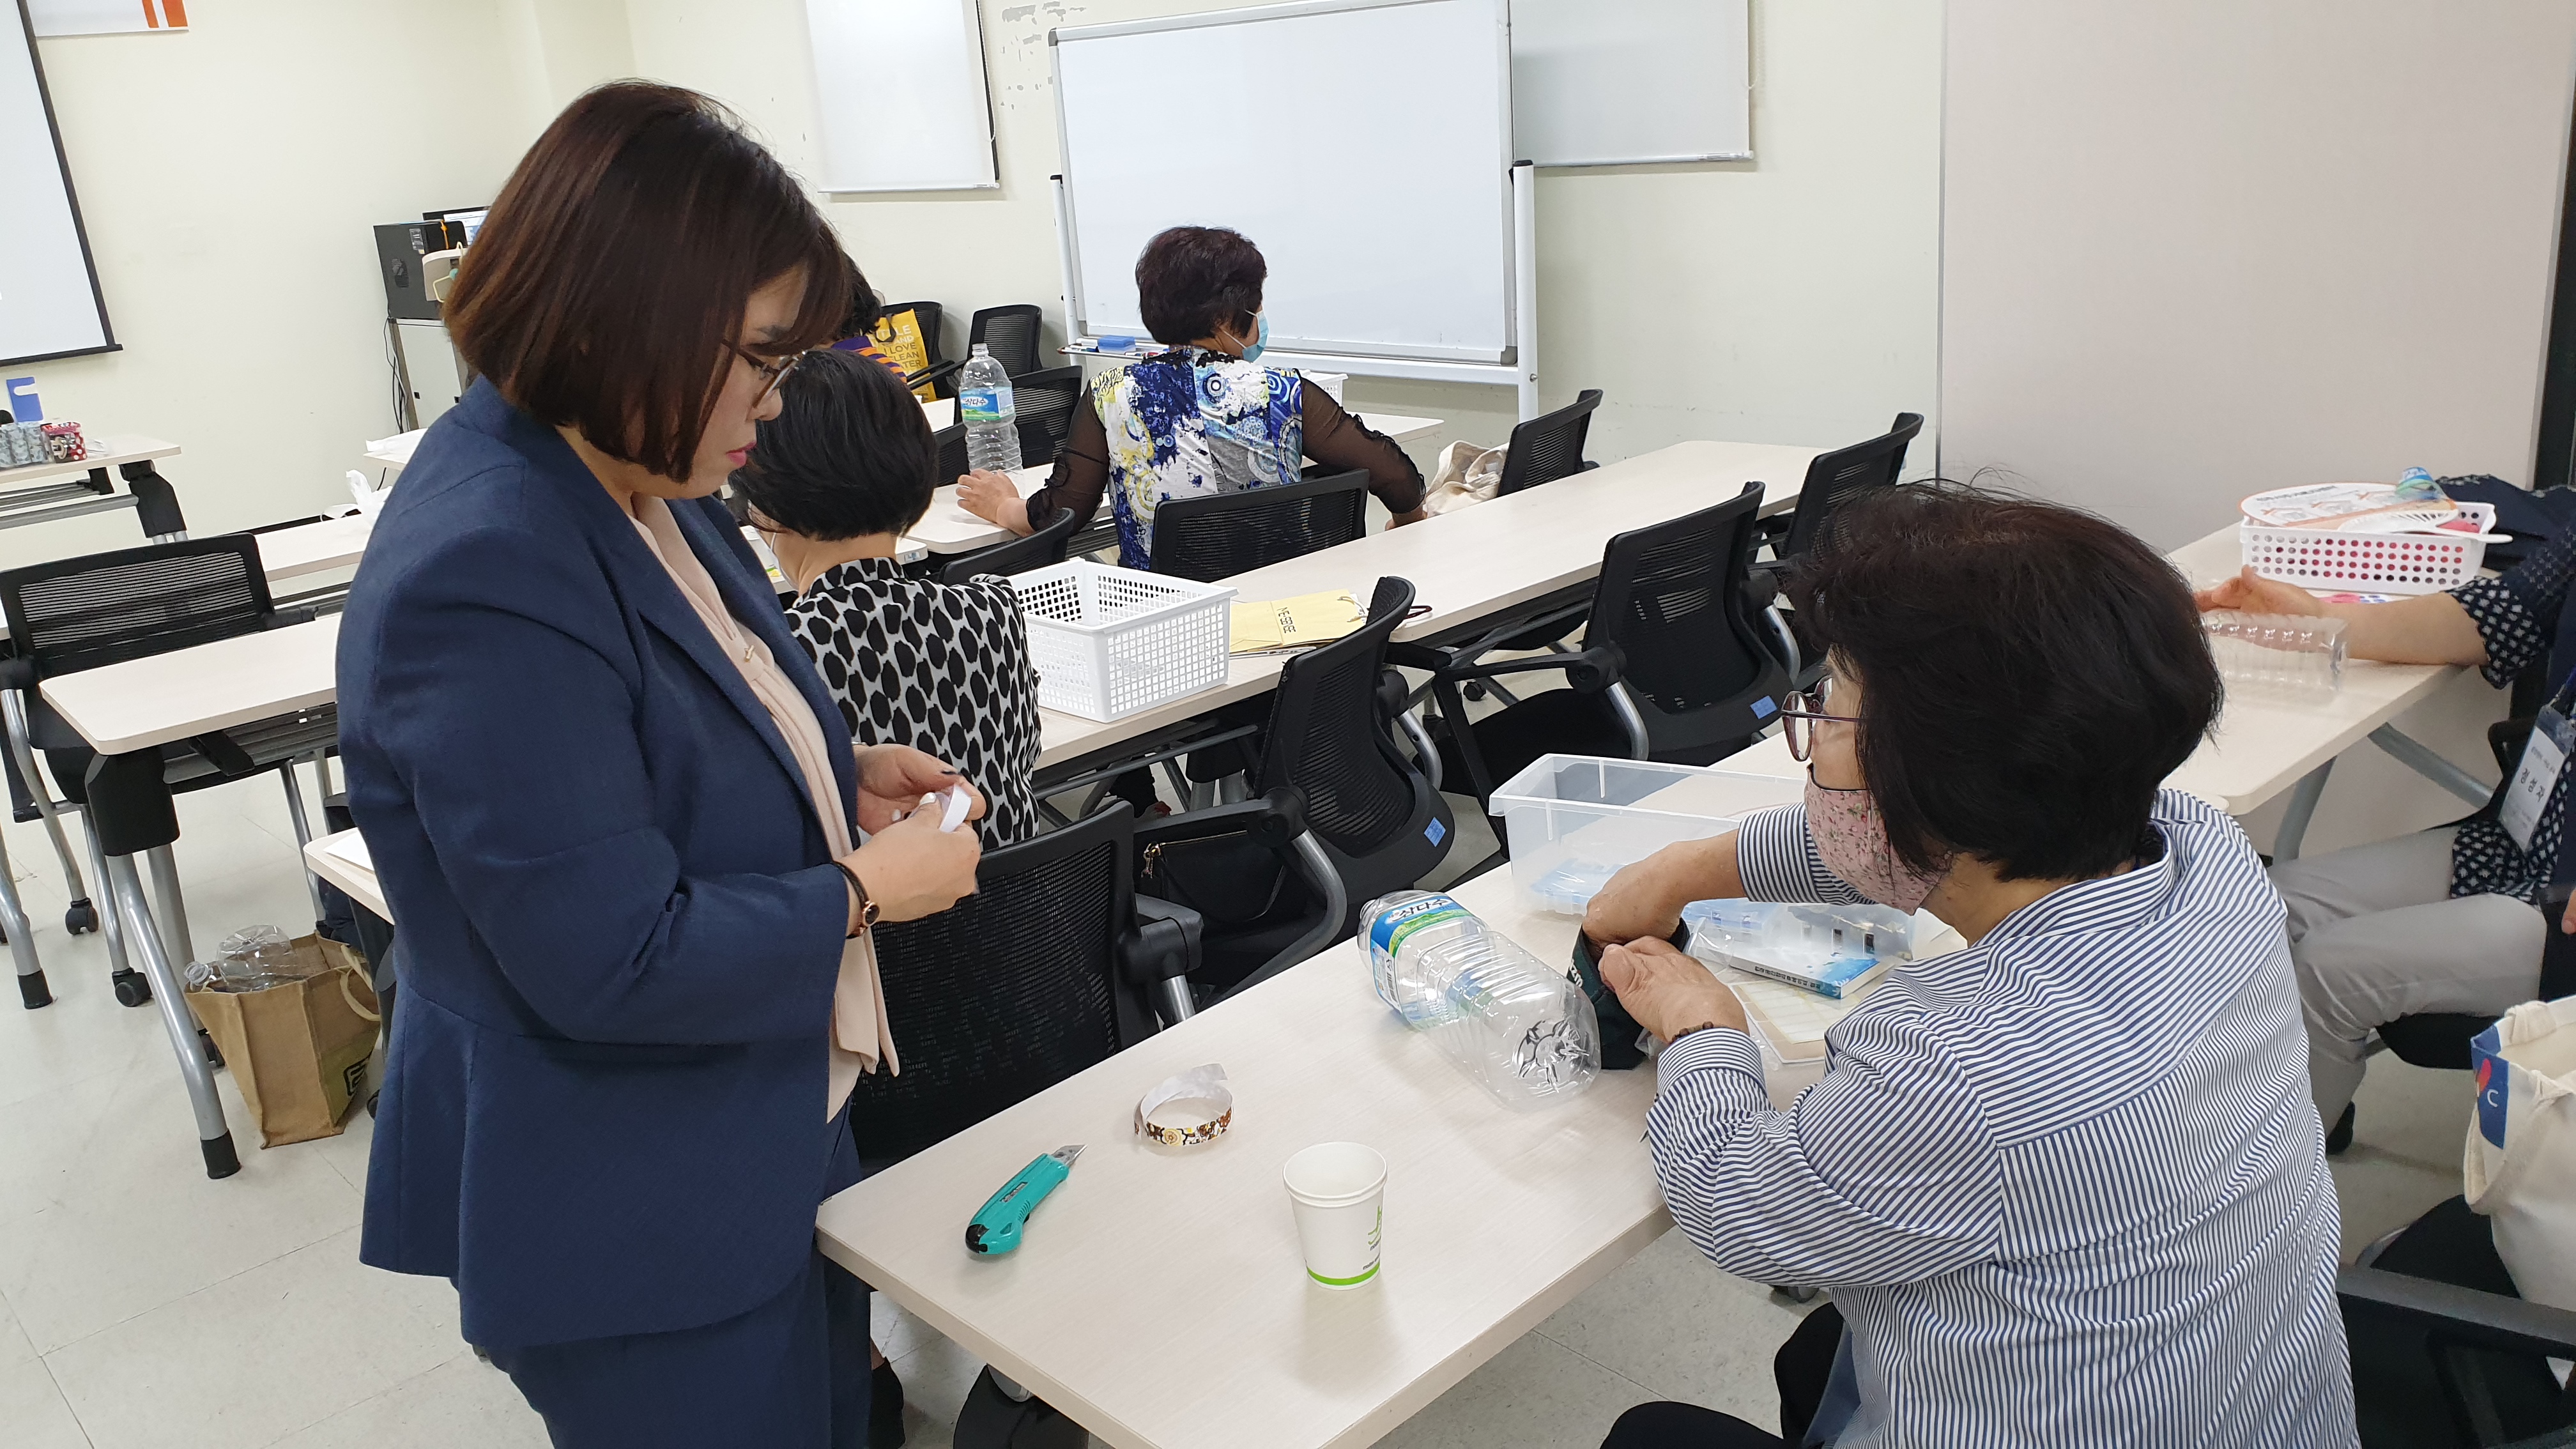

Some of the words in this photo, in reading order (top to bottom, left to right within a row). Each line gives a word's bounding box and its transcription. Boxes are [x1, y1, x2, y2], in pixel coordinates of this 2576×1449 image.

[889, 342, 917, 355] LOVE
[888, 351, 919, 362] LEAN
[965, 397, 986, 406] 삼다수
[1393, 898, 1449, 922] 삼다수
